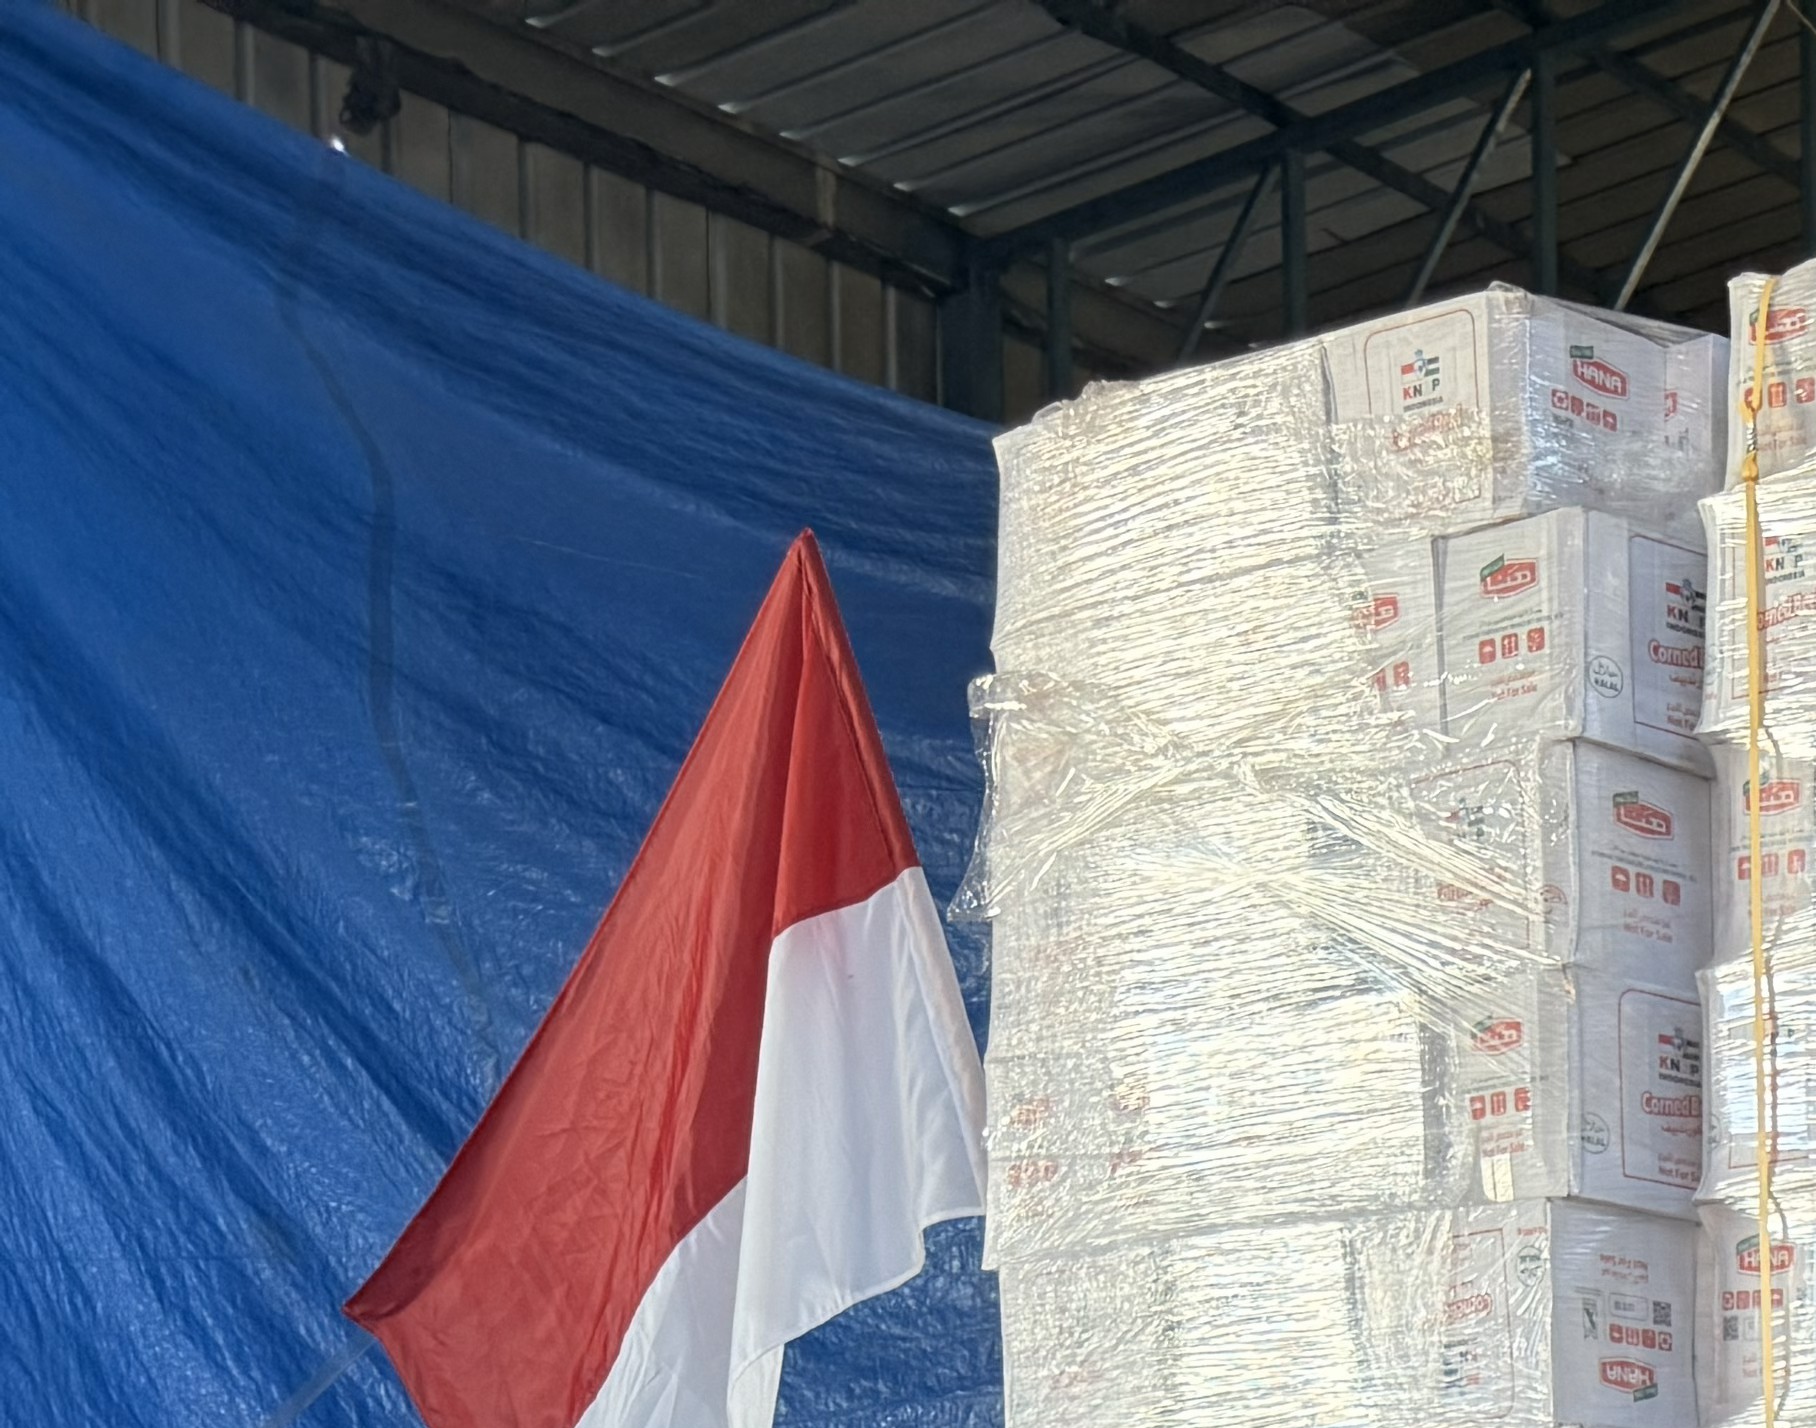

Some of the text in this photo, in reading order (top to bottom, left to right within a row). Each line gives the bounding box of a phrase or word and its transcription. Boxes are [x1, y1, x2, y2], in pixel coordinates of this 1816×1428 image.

[1402, 376, 1441, 401] KNP
[1575, 361, 1624, 394] HANA
[1658, 1054, 1700, 1076] KNP
